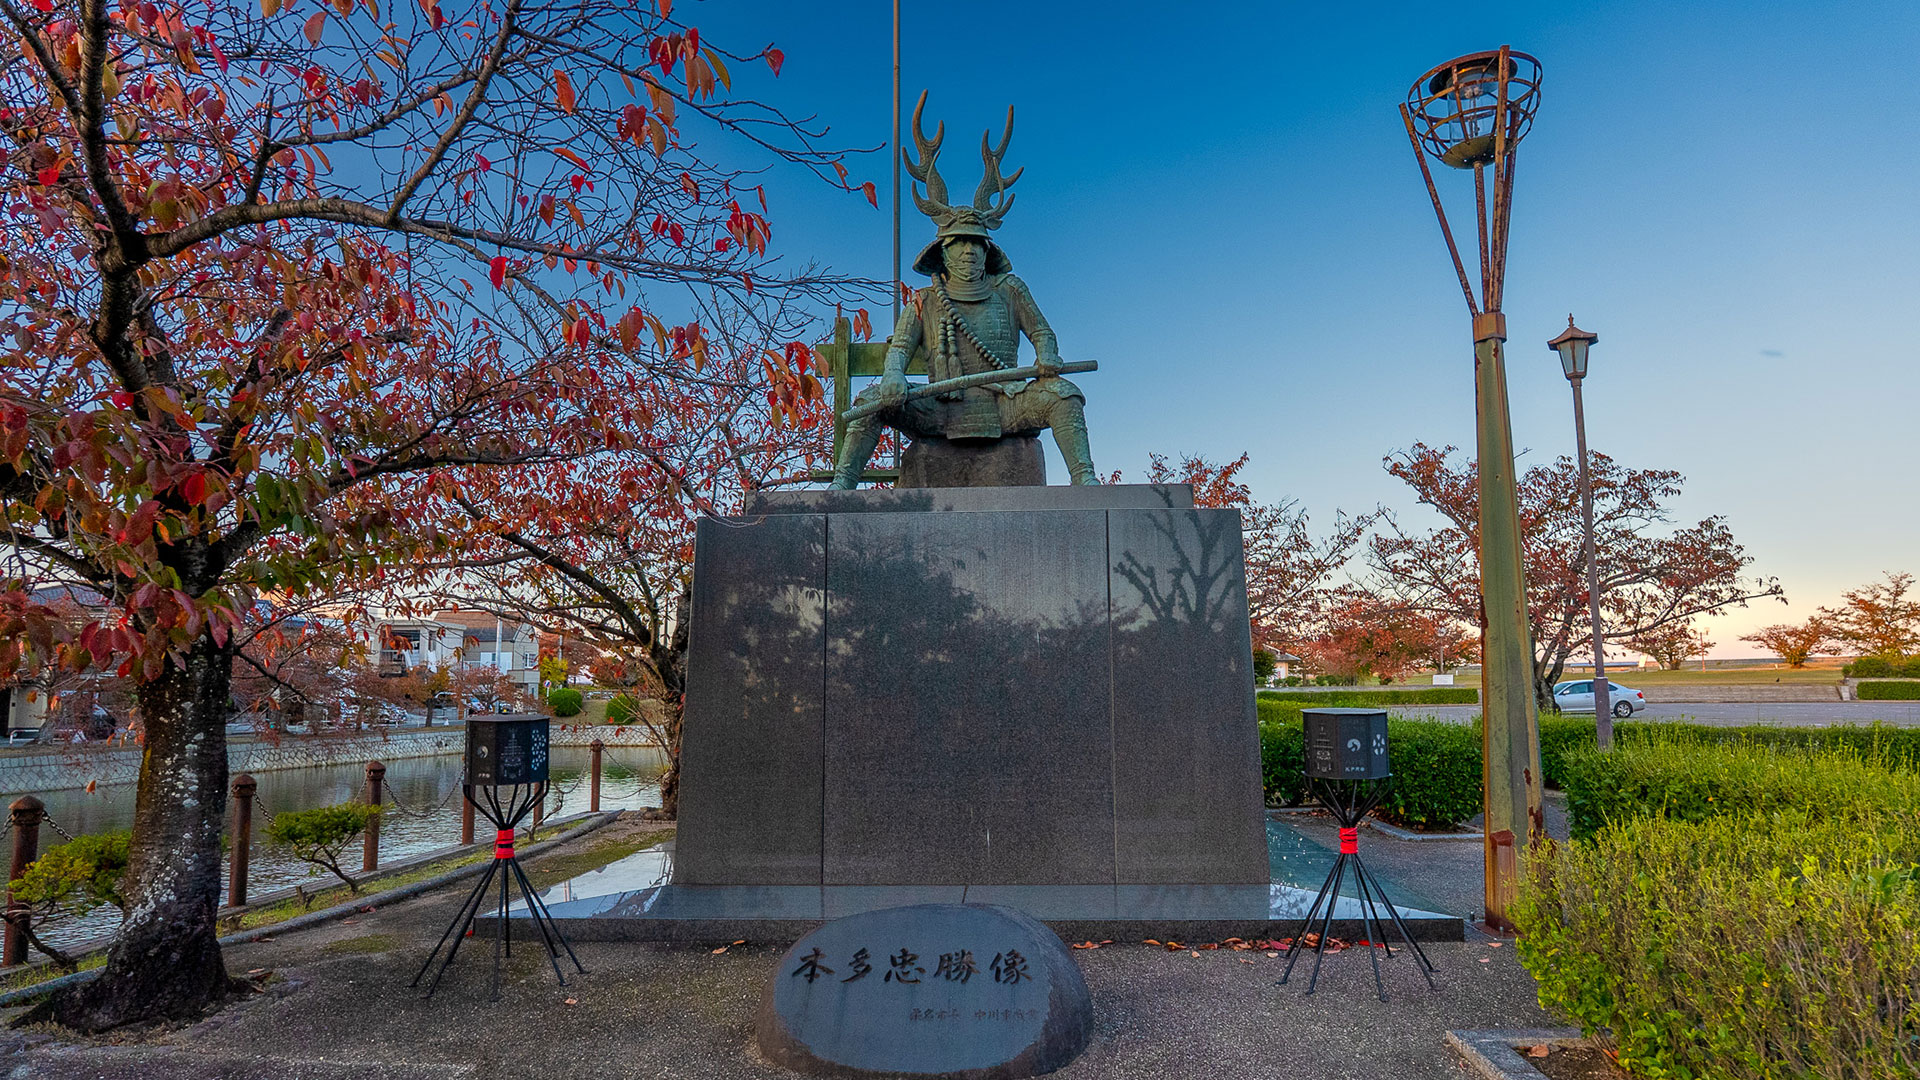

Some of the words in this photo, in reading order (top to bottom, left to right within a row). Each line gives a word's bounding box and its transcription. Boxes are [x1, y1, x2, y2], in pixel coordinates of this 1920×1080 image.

[792, 947, 1033, 985] 本多忠勝像
